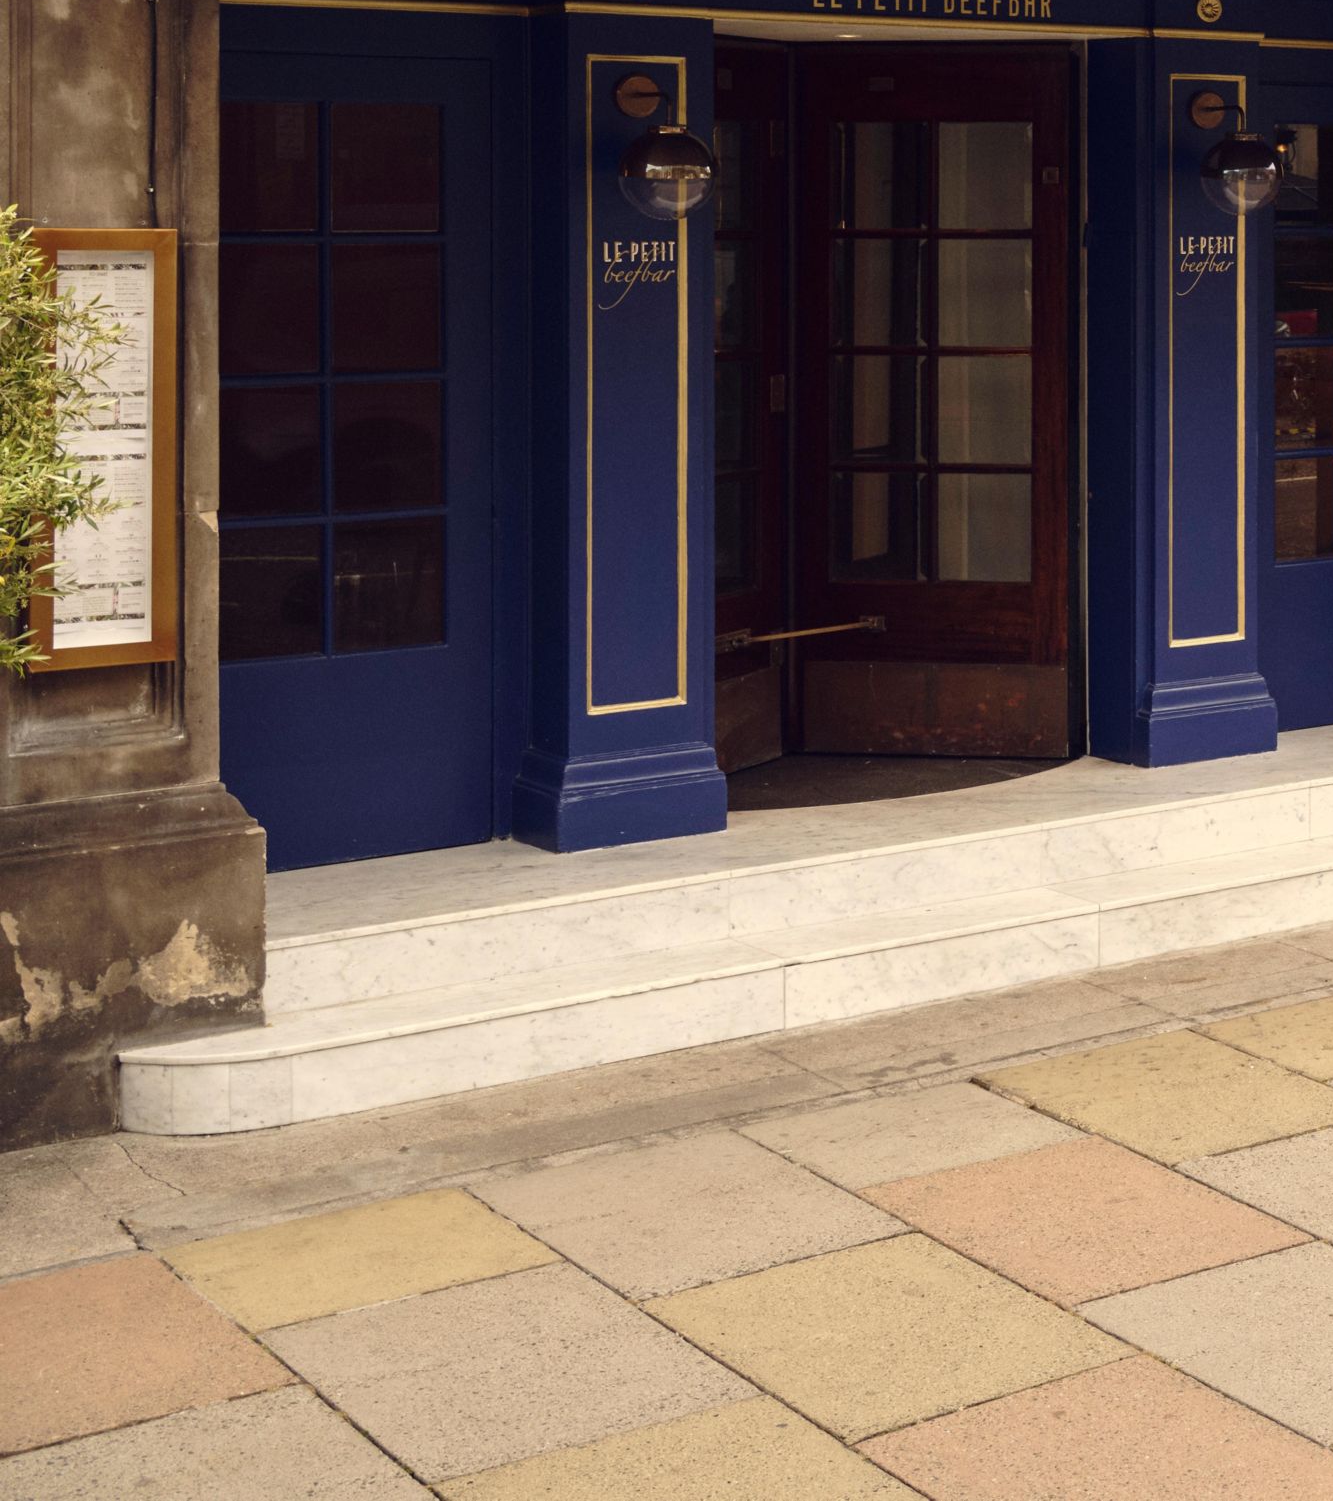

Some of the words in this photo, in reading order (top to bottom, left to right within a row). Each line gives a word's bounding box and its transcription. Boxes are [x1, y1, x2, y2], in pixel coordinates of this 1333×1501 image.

[603, 240, 623, 263] LE
[630, 240, 676, 262] PETIT
[1179, 235, 1195, 255] LE
[1199, 235, 1235, 255] PETIT
[598, 249, 676, 311] beefbar
[1176, 243, 1235, 296] beefbar
